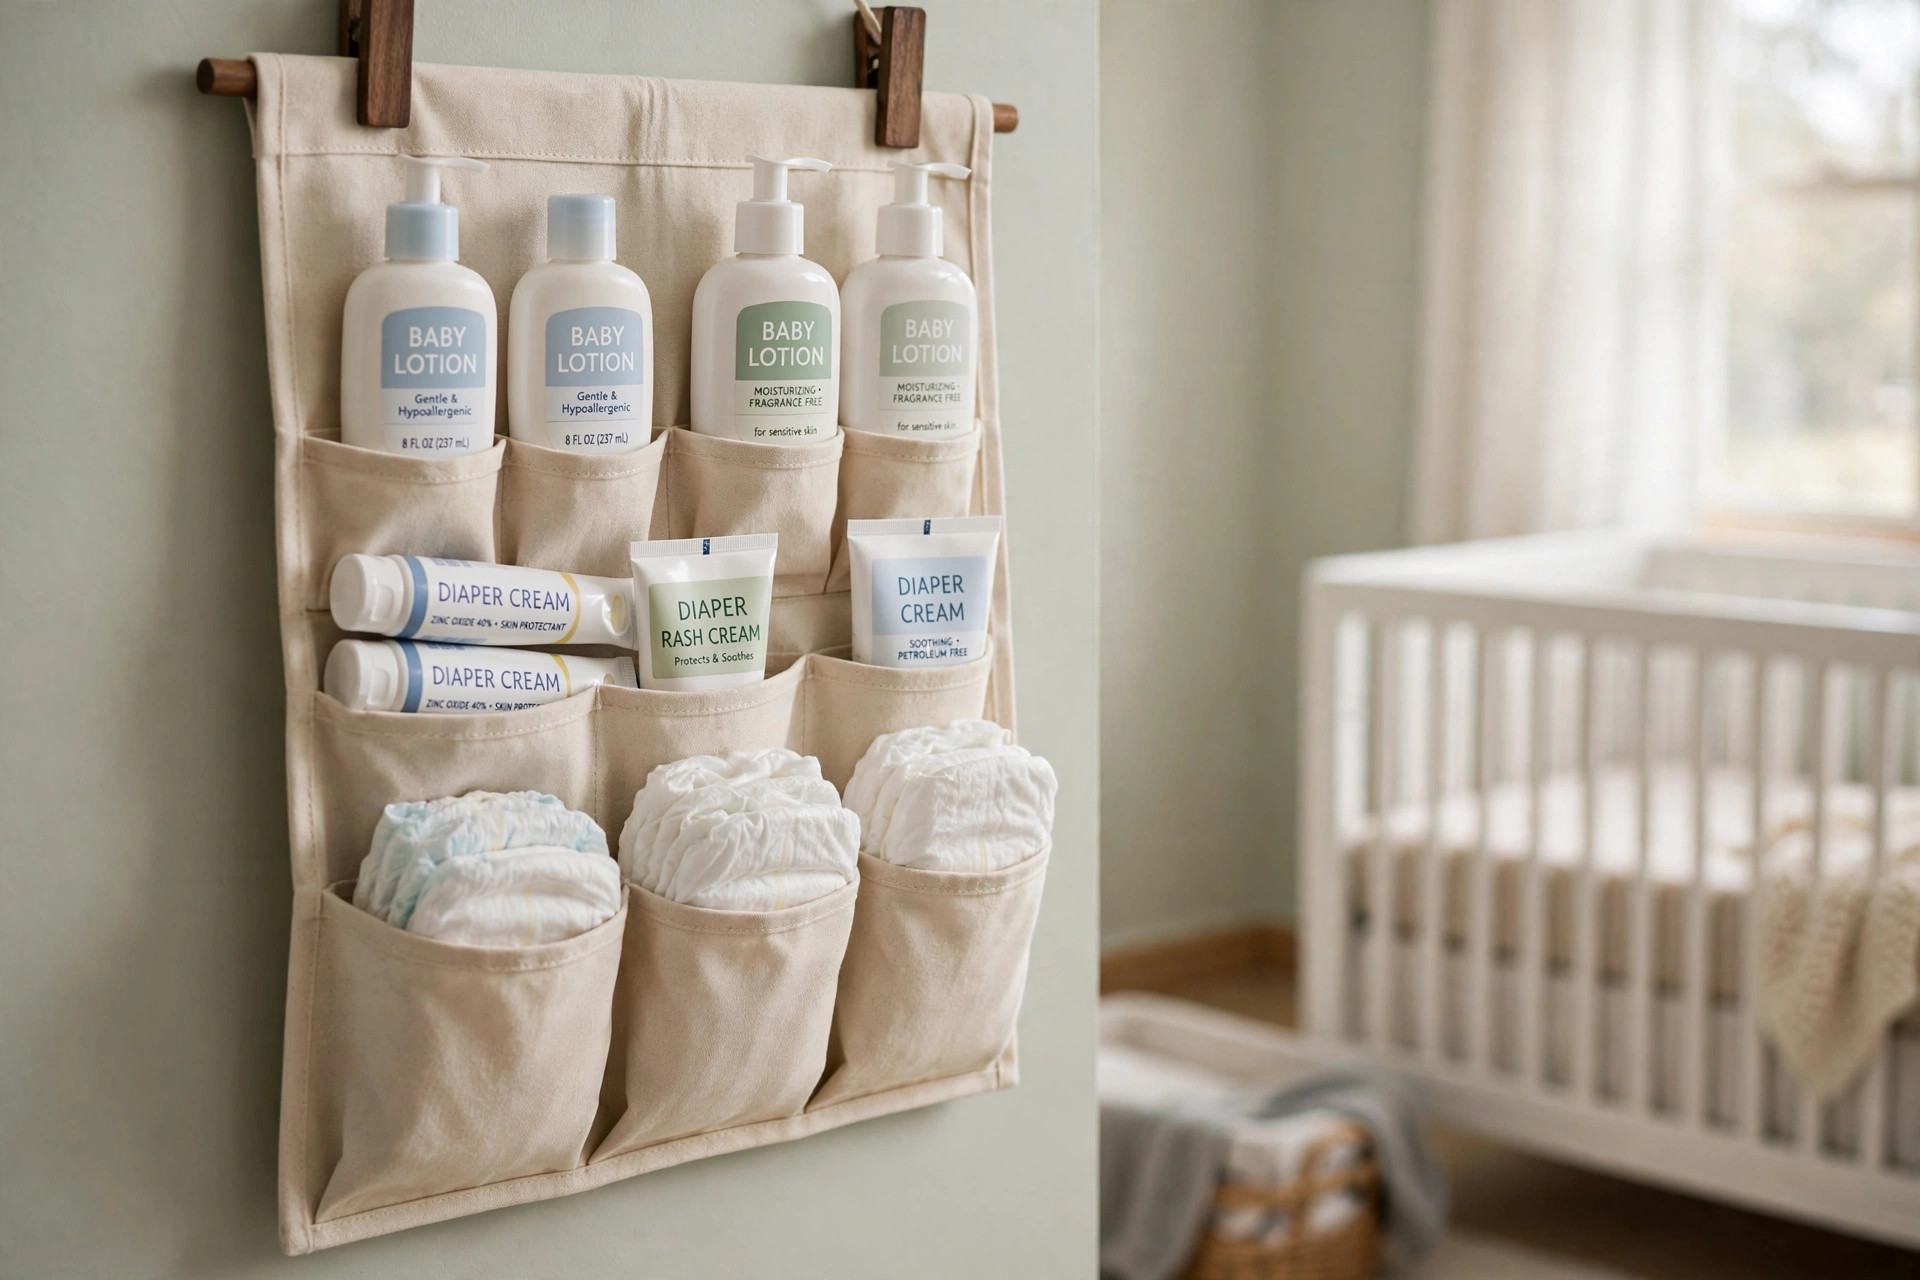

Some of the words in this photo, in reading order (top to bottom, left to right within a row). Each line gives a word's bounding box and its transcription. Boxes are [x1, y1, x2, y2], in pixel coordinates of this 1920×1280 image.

[571, 325, 625, 346] BABY
[762, 320, 815, 341] BABY
[905, 319, 954, 339] BABY
[409, 326, 467, 348] BABY
[748, 346, 823, 367] LOTION
[892, 344, 962, 364] LOTION
[394, 353, 477, 375] LOTION
[557, 351, 634, 373] LOTION
[754, 385, 817, 396] MOISTURIZING
[897, 382, 956, 392] MOISTURIZING
[414, 393, 449, 405] Gentle
[450, 393, 458, 404] &
[577, 391, 609, 401] Gentle
[610, 390, 618, 401] &
[749, 398, 803, 408] FRAGRANCE
[804, 397, 823, 407] FREE
[893, 393, 943, 404] FRAGRANCE
[944, 393, 962, 403] FREE
[398, 405, 472, 420] Hypoallergenic
[561, 402, 631, 417] Hypoallergenic
[754, 426, 766, 437] for
[769, 426, 802, 437] sensitive
[803, 425, 818, 436] skin
[897, 421, 909, 432] for
[911, 421, 942, 431] sensitive
[402, 438, 408, 449] 8
[410, 438, 420, 449] FL
[421, 438, 434, 449] OZ
[435, 437, 454, 451] (237
[565, 434, 571, 446] 8
[572, 434, 582, 446] FL
[583, 434, 596, 446] OZ
[596, 433, 614, 446] (237
[615, 432, 629, 444] mL)
[898, 574, 965, 596] DIAPER
[438, 581, 503, 607] DIAPER
[509, 588, 570, 612] CREAM
[678, 596, 748, 621] DIAPER
[901, 602, 965, 624] CREAM
[431, 615, 450, 625] ZINC
[451, 617, 475, 627] OXIDE
[476, 618, 492, 627] 40%
[500, 620, 518, 629] SKIN
[519, 621, 567, 632] PROTECTANT
[661, 628, 704, 648] RASH
[708, 624, 761, 645] CREAM
[909, 637, 953, 649] SOOTHING
[674, 655, 710, 666] Protects
[712, 653, 719, 664] &
[721, 651, 755, 663] Soothes
[897, 650, 947, 661] PETROLEUM
[949, 647, 968, 657] FREE
[432, 665, 496, 689] DIAPER
[501, 670, 561, 693] CREAM
[426, 699, 445, 709] ZINC
[446, 700, 470, 710] OXIDE
[471, 701, 487, 711] 40%
[495, 702, 513, 712] SKIN
[514, 703, 543, 711] PROT
